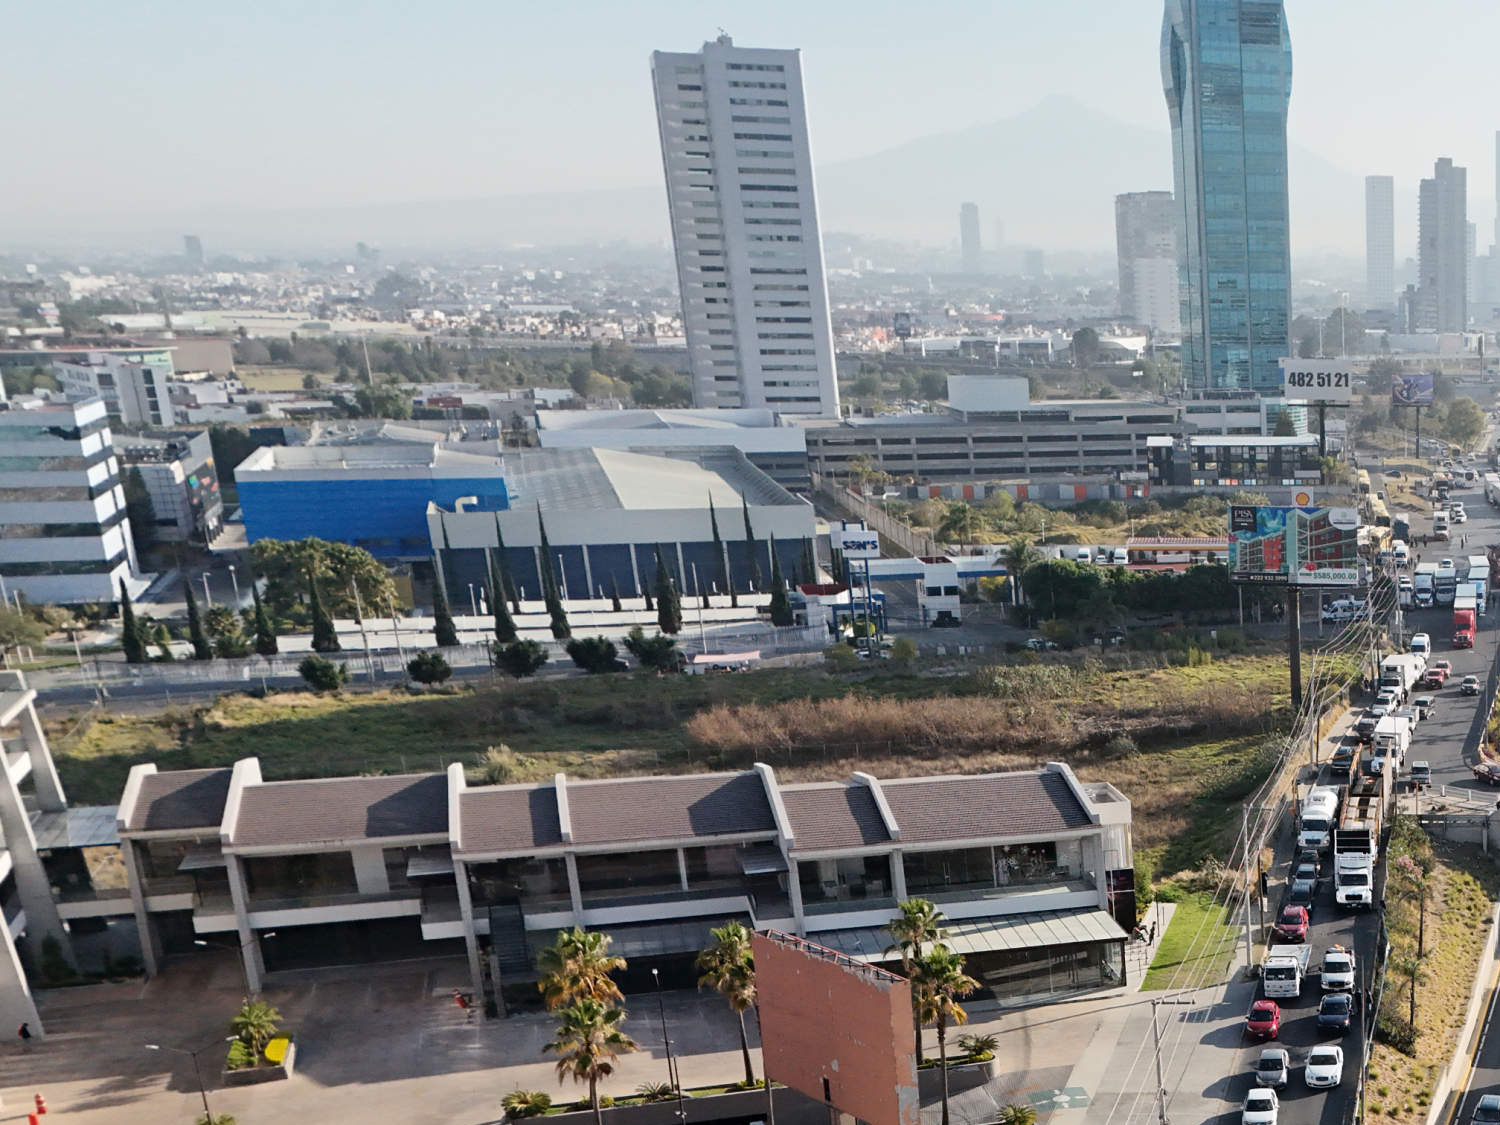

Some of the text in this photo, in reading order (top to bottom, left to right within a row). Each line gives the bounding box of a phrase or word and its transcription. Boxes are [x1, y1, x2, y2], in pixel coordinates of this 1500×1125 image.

[1288, 371, 1349, 387] 482 51 21
